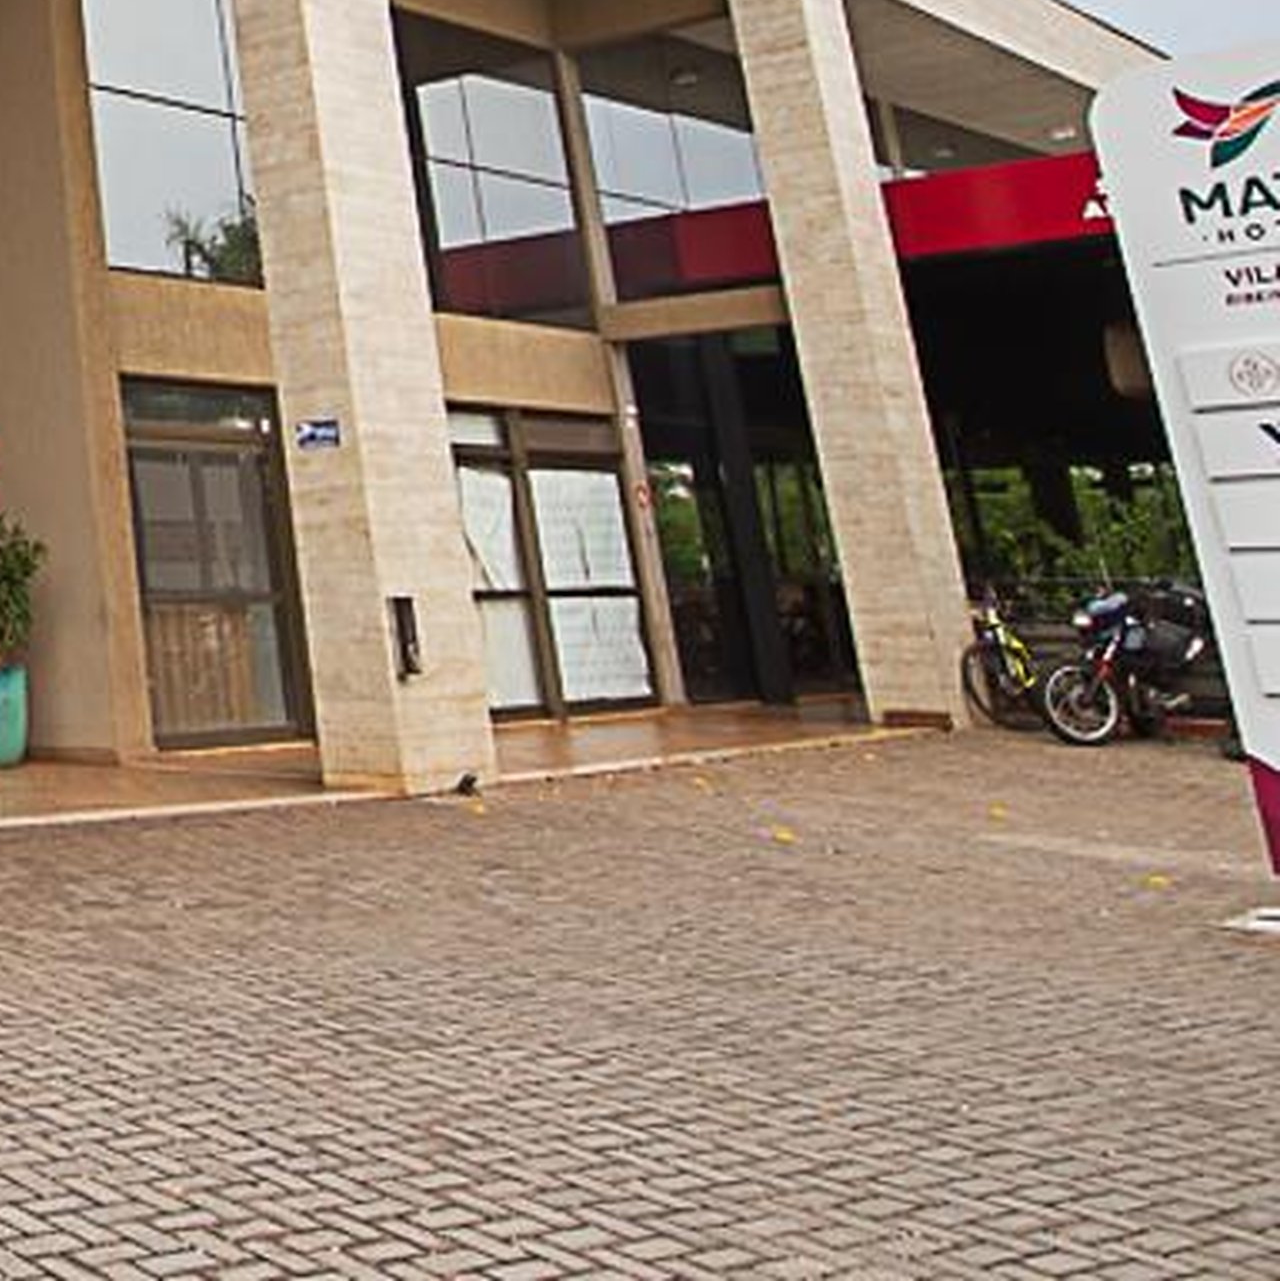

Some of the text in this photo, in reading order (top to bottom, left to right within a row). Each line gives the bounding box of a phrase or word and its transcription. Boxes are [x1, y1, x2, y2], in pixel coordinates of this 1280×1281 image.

[1179, 173, 1280, 224] MA
[1217, 219, 1280, 242] HO
[1225, 265, 1280, 287] VIL
